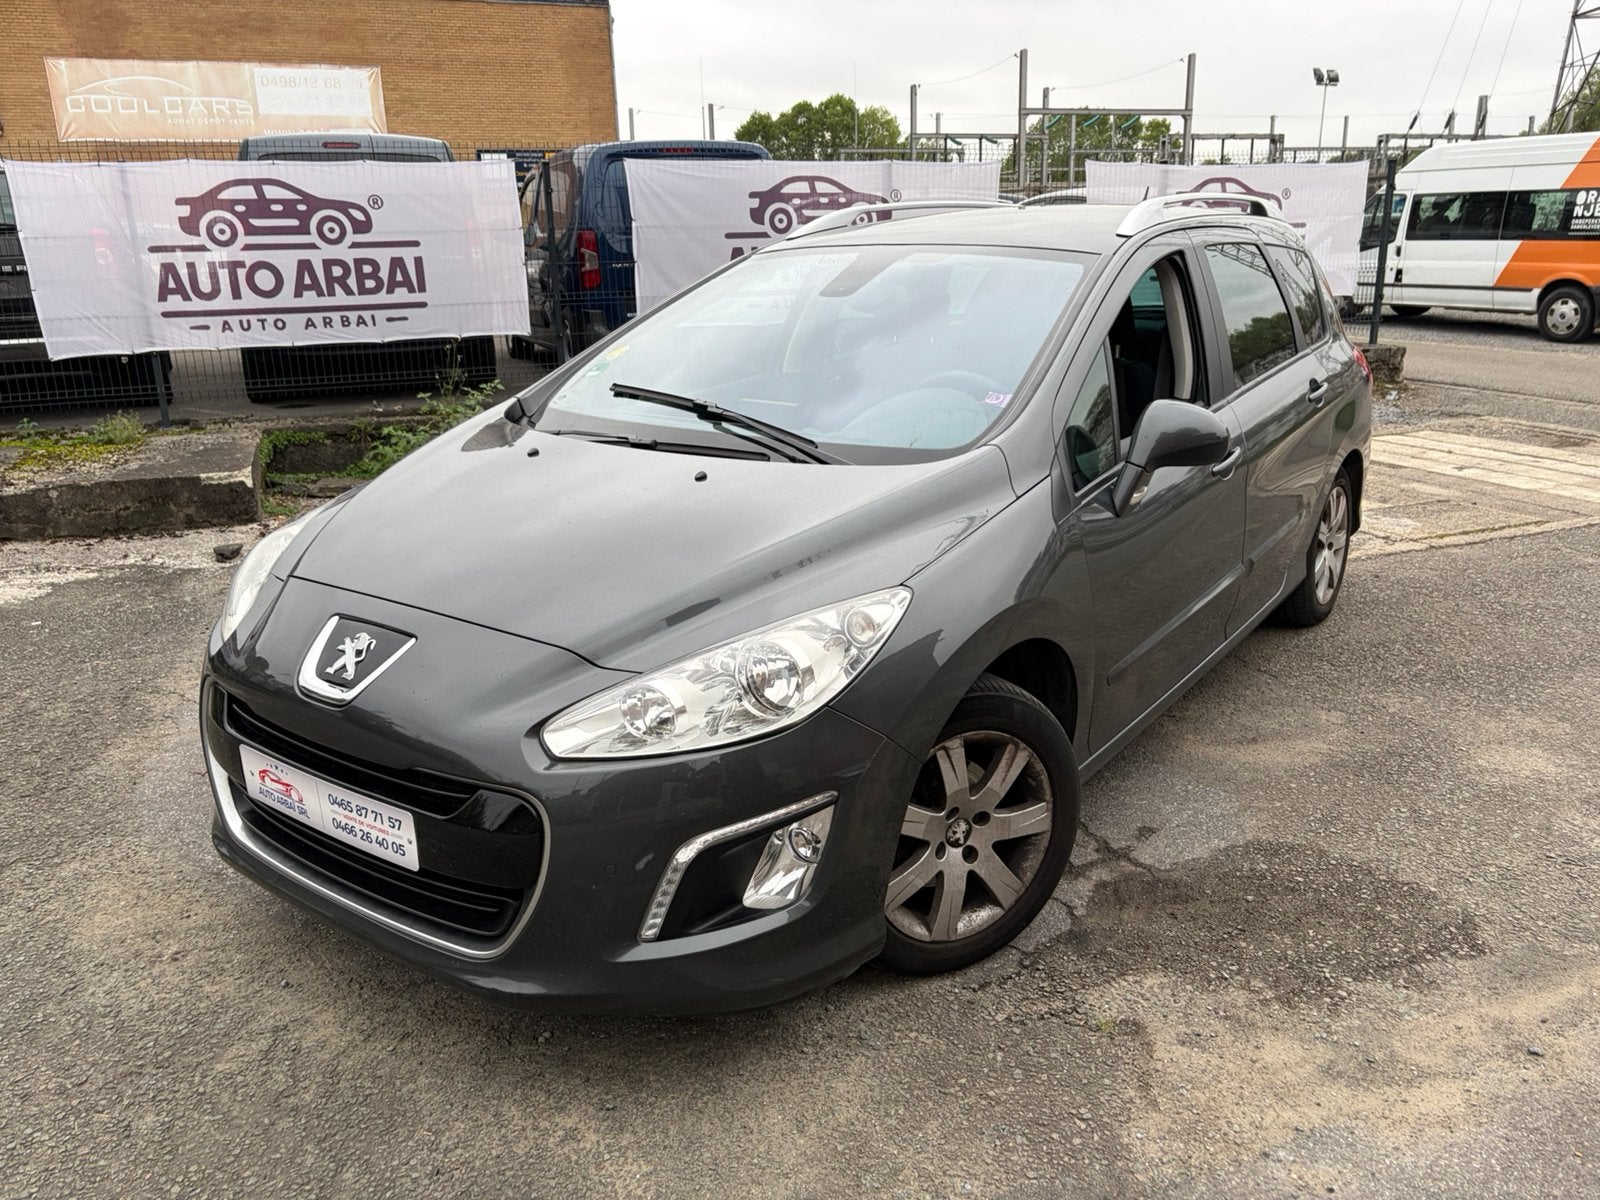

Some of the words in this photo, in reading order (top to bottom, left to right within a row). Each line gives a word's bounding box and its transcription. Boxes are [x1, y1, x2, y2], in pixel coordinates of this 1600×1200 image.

[157, 260, 285, 303] AUTO
[293, 256, 427, 299] ARBAI
[221, 318, 287, 333] AUTO
[304, 314, 377, 330] ARBAI
[259, 786, 276, 802] AUTO
[297, 805, 311, 820] SRL
[328, 793, 353, 813] 0465
[355, 804, 369, 819] 87
[370, 809, 384, 825] 71
[387, 816, 402, 831] 57
[332, 817, 357, 838] 0466
[358, 828, 373, 844] 26
[375, 835, 389, 851] 40
[391, 841, 406, 857] 05
